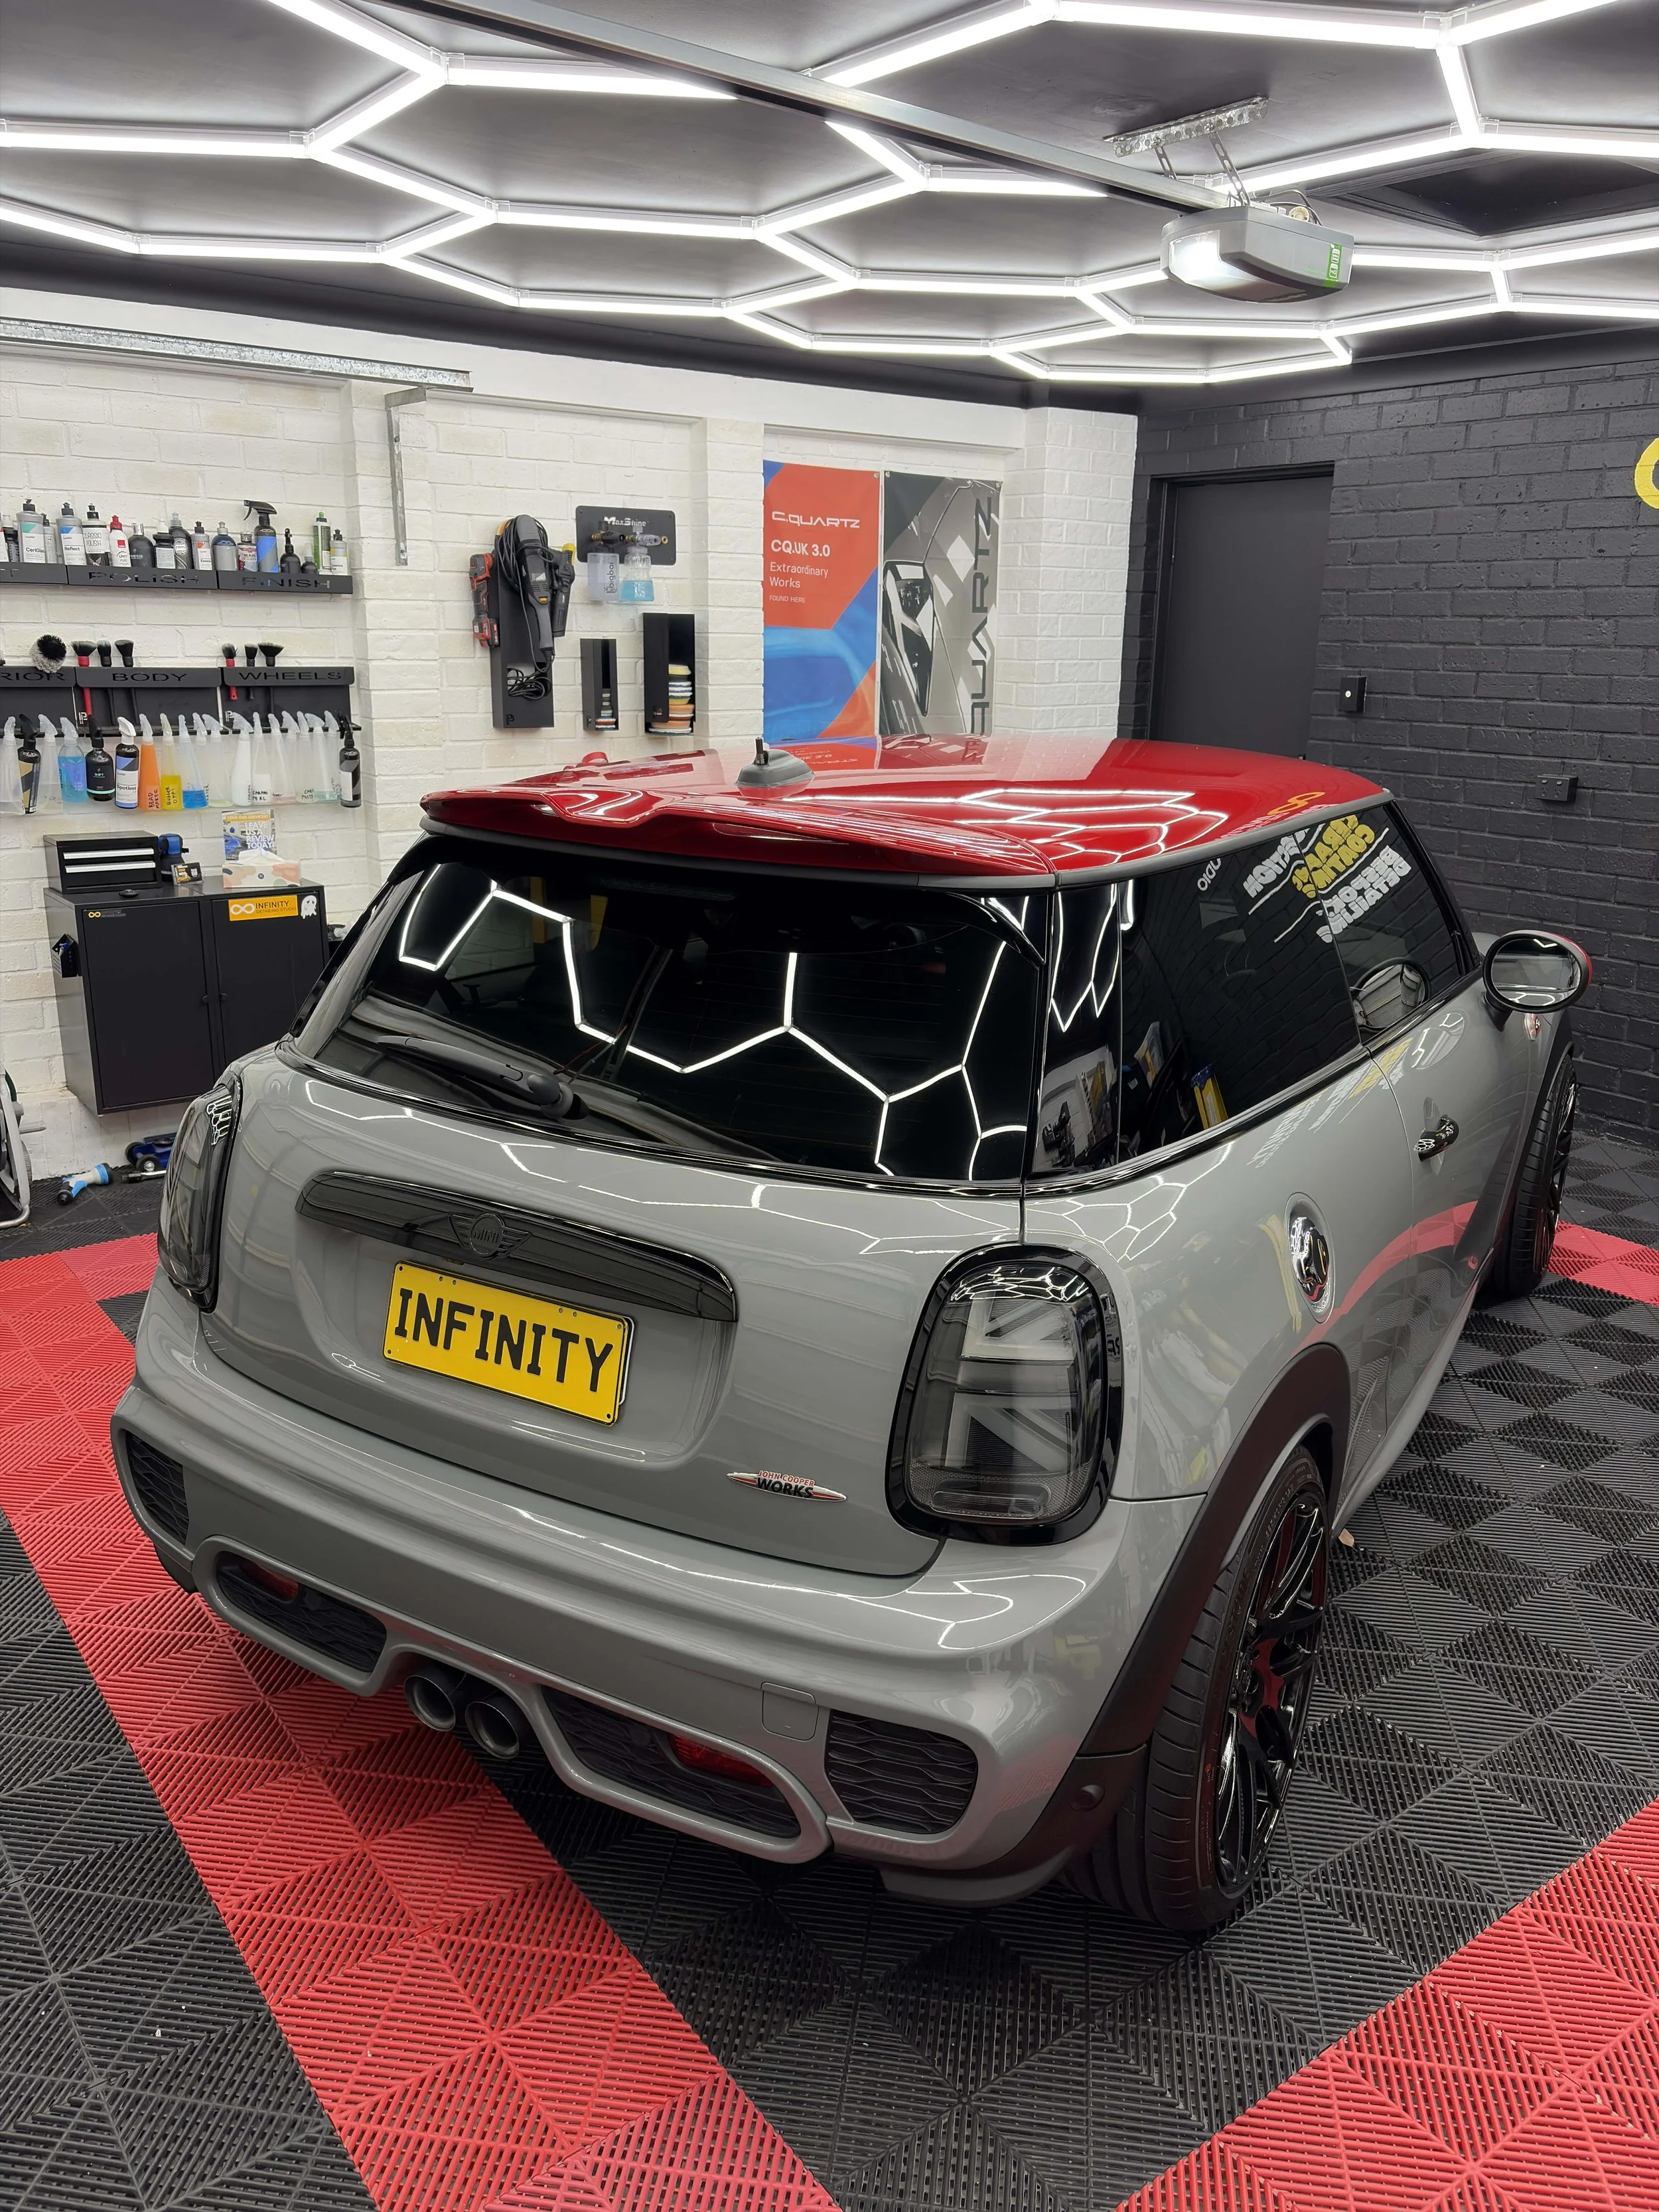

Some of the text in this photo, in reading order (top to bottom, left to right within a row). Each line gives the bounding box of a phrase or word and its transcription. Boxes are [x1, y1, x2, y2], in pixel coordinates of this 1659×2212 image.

[770, 539, 831, 557] CQ.UK 3.0
[770, 561, 829, 579] Extraordinary
[88, 572, 198, 583] POLISH
[242, 577, 330, 589] FINISH
[769, 576, 801, 588] Works
[111, 672, 187, 682] BODY
[239, 672, 342, 680] WHEELS
[255, 901, 289, 909] INFINITY
[474, 1229, 499, 1244] MINI
[395, 1288, 614, 1392] INFINITY
[758, 1471, 815, 1487] JOHN COOPER
[757, 1477, 814, 1498] WORKS
